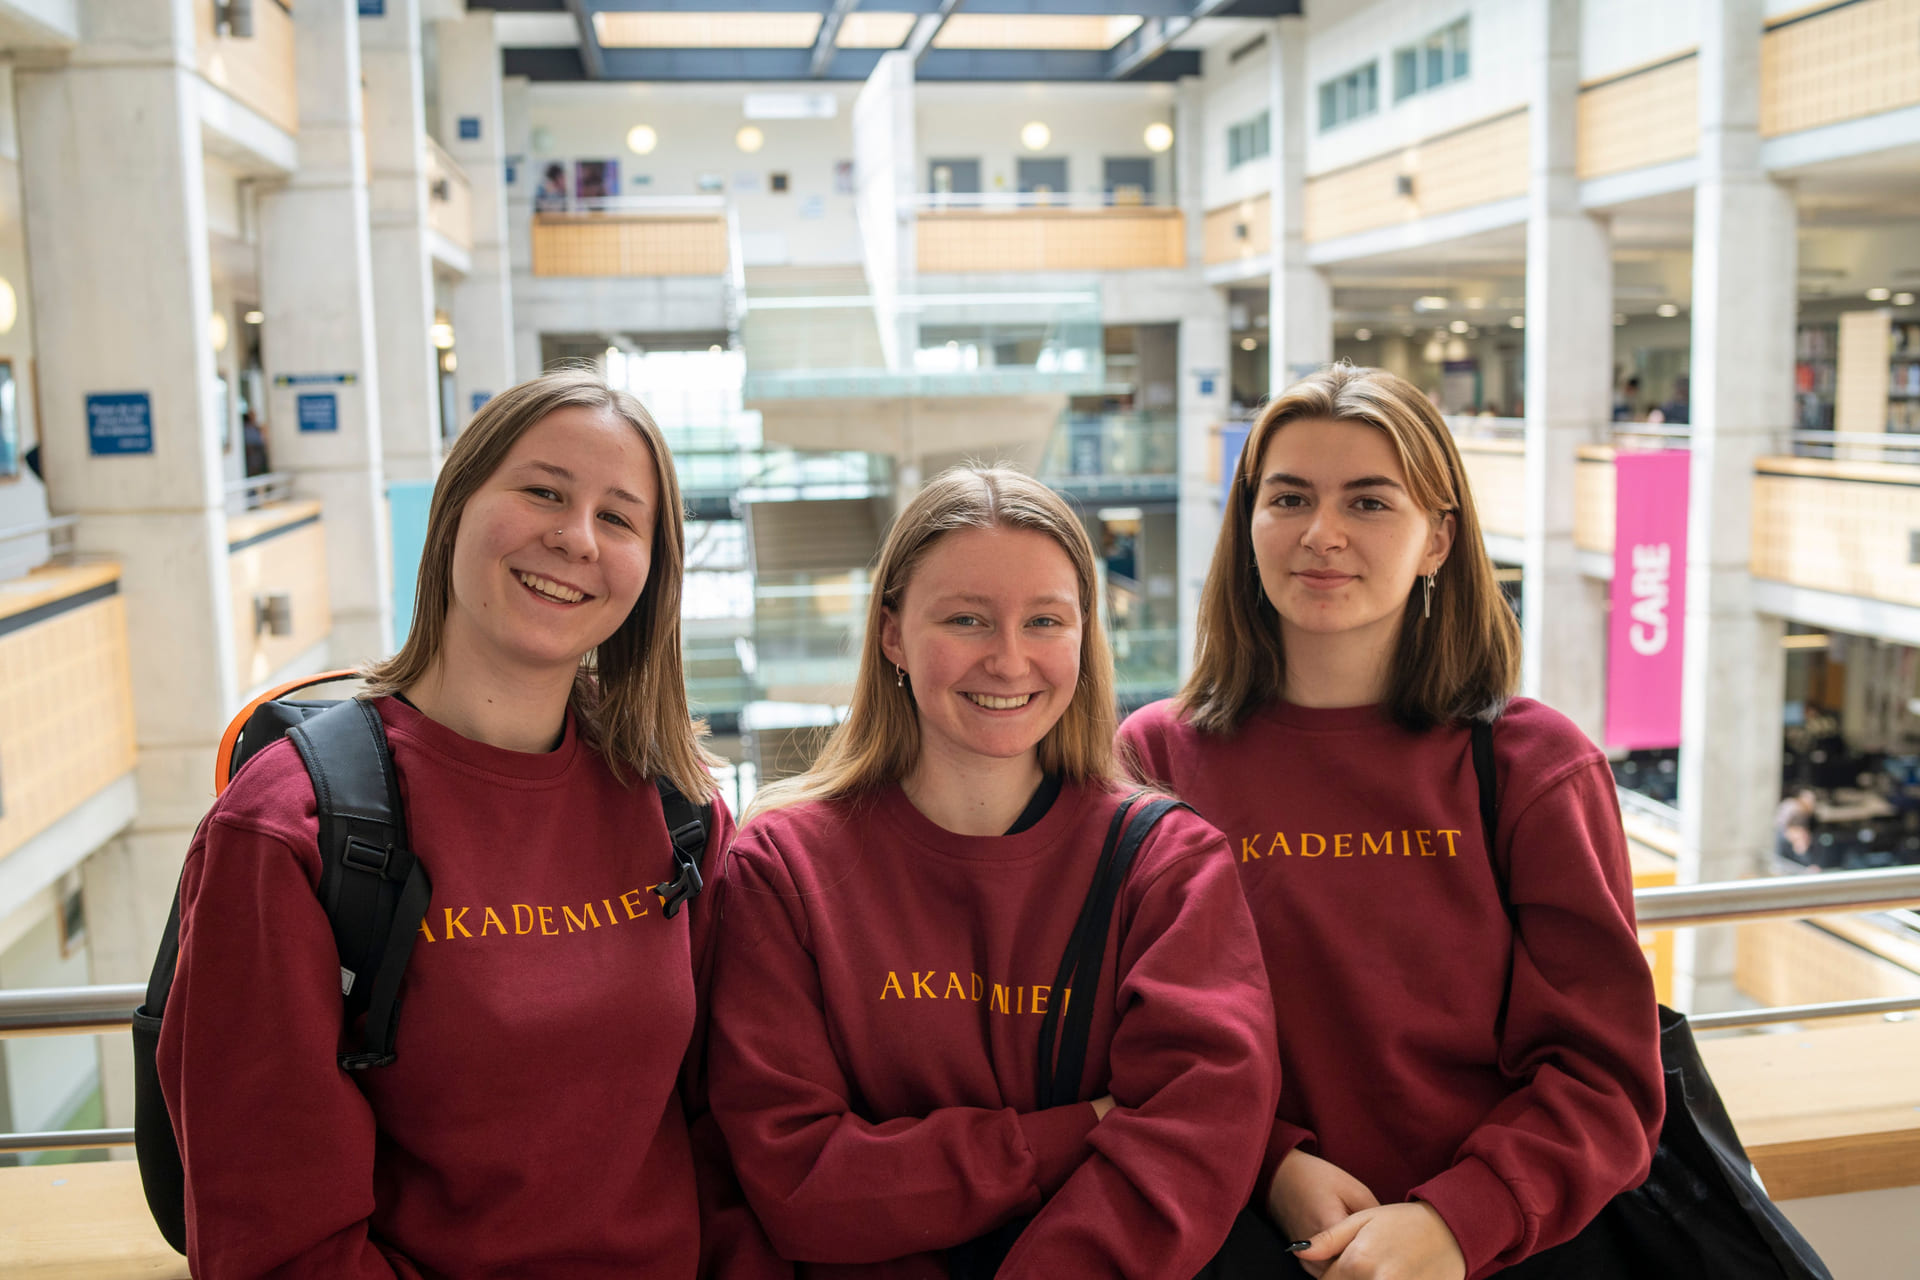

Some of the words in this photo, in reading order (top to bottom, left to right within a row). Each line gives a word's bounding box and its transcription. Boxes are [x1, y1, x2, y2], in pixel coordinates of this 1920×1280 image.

[1630, 543, 1671, 656] CARE
[1242, 830, 1462, 863] KADEMIET
[879, 971, 1072, 1017] AKADMIE
